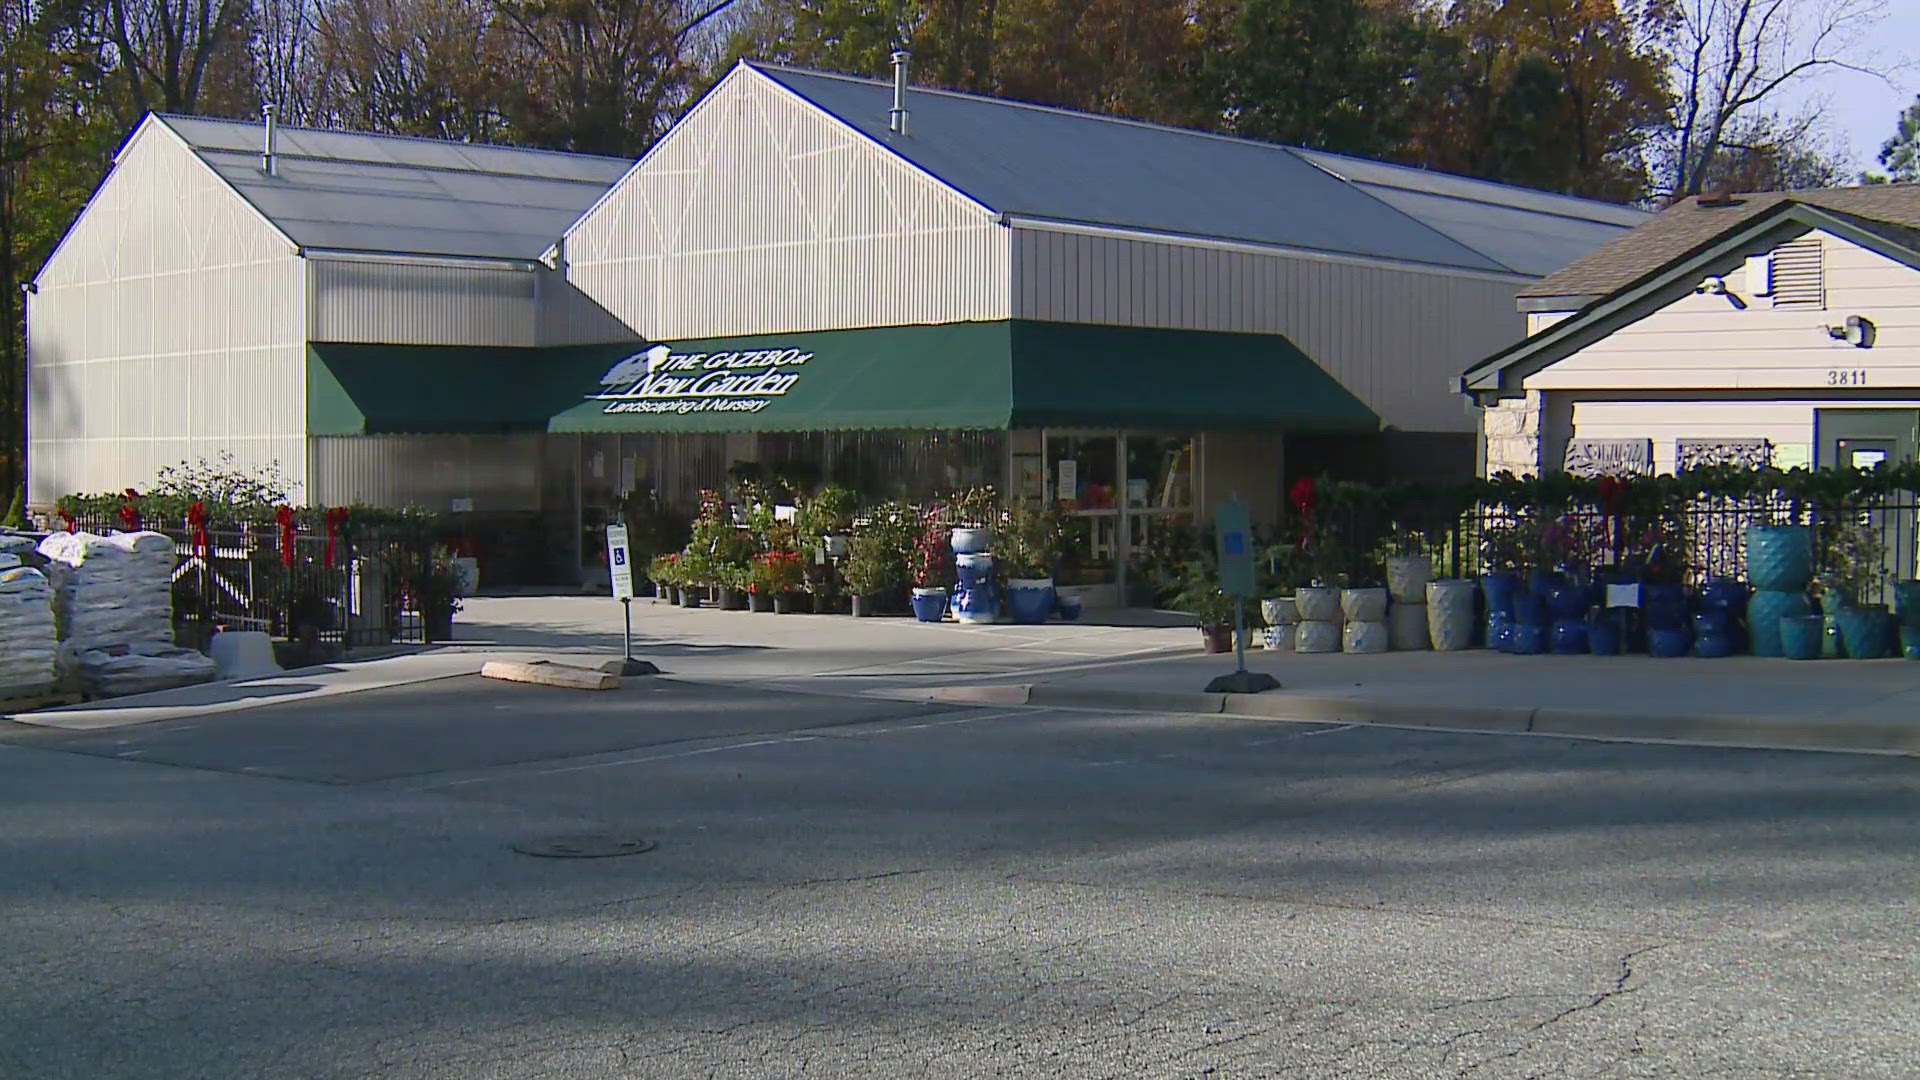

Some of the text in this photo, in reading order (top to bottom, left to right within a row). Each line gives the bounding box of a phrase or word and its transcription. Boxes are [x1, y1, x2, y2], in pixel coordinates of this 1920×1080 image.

[660, 353, 706, 371] THE
[703, 349, 799, 369] GAZEBO
[627, 367, 799, 395] New Garden
[1828, 370, 1866, 385] 3811
[603, 398, 771, 414] Landscaping & Nursery
